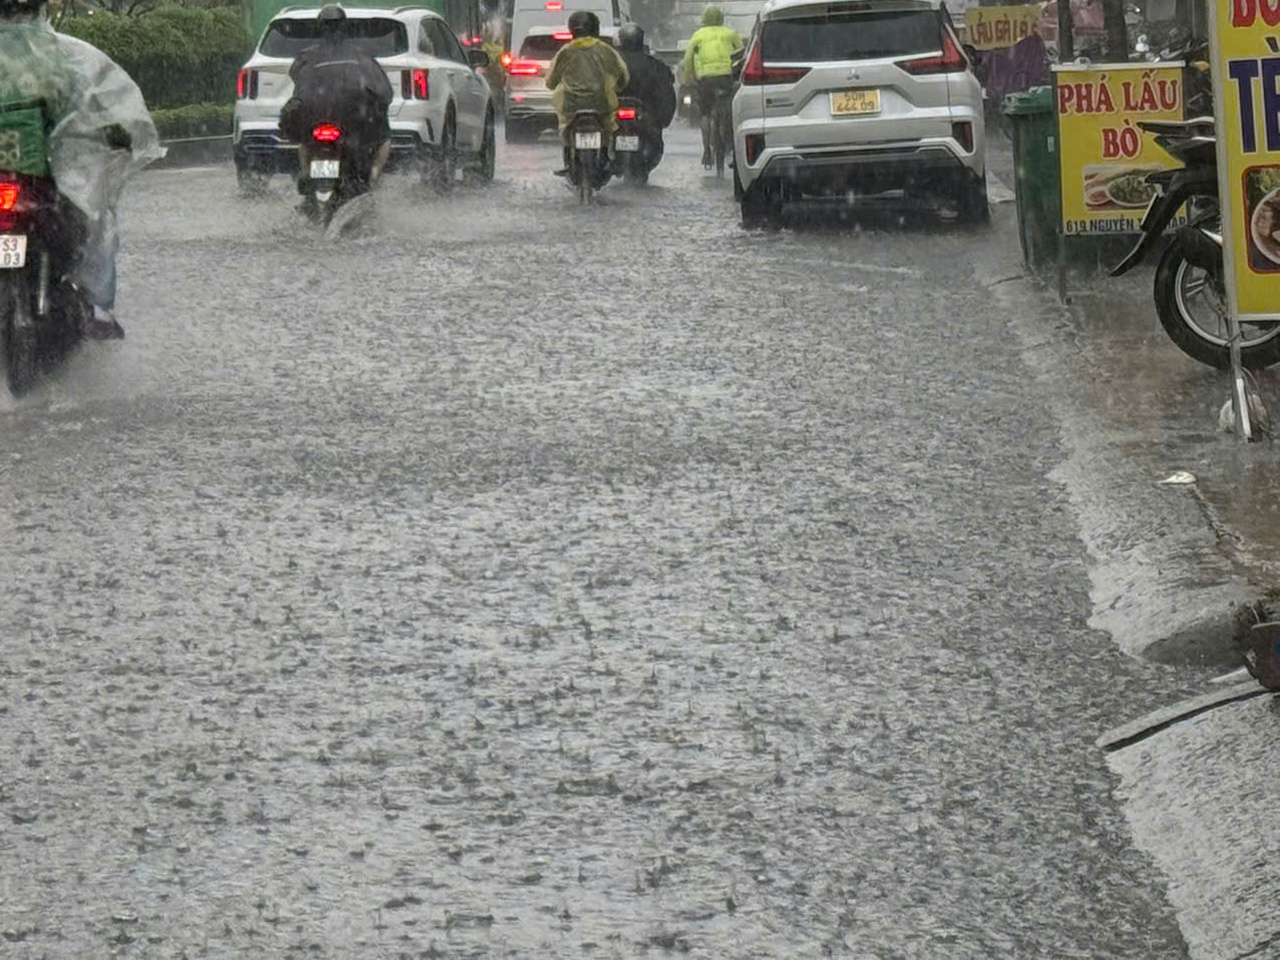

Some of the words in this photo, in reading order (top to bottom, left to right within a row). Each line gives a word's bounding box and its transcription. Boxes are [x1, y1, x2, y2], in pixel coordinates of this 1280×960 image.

[1059, 73, 1115, 115] PHÁ
[1122, 69, 1178, 112] LẤU
[1102, 119, 1140, 158] BÒ
